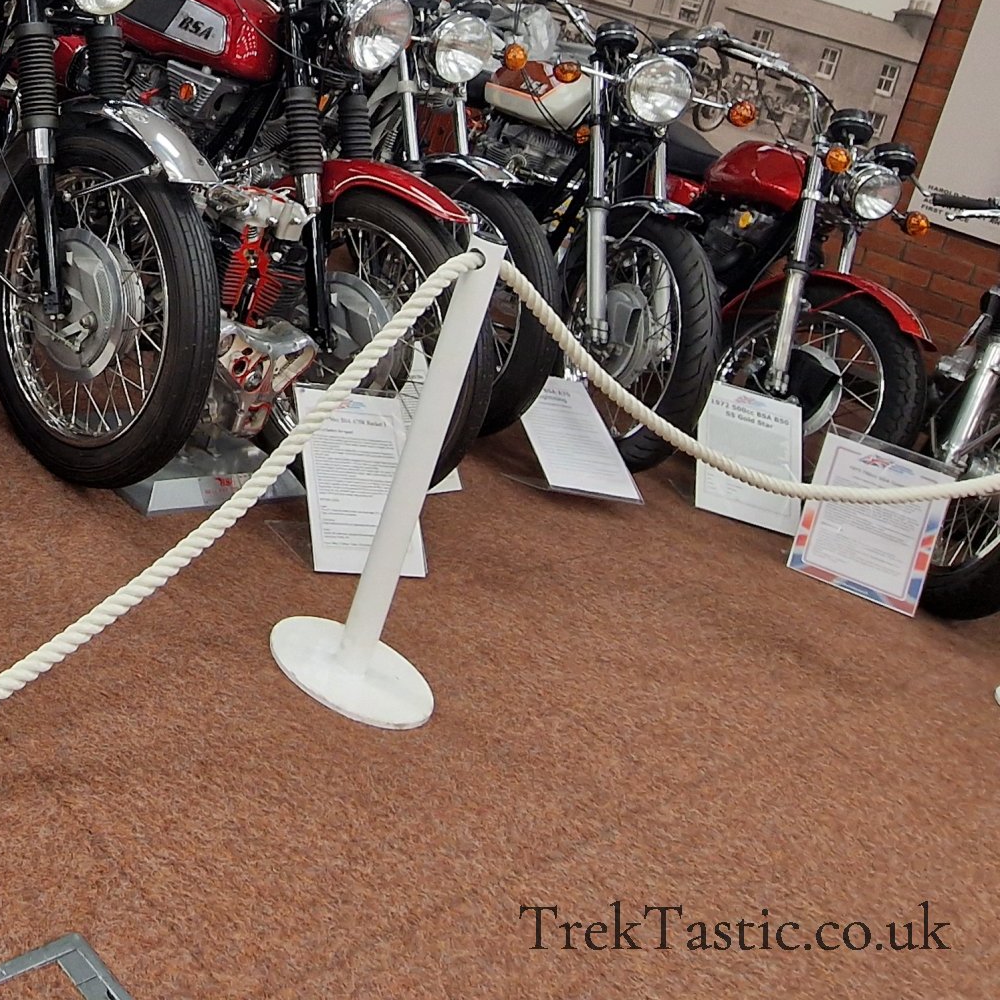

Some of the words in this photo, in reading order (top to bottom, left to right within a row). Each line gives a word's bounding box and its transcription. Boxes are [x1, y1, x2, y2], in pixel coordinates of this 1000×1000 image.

[178, 16, 214, 40] BSA
[920, 203, 943, 215] FIRST
[737, 414, 756, 424] Gold
[757, 420, 773, 429] Star
[756, 411, 772, 420] BSA
